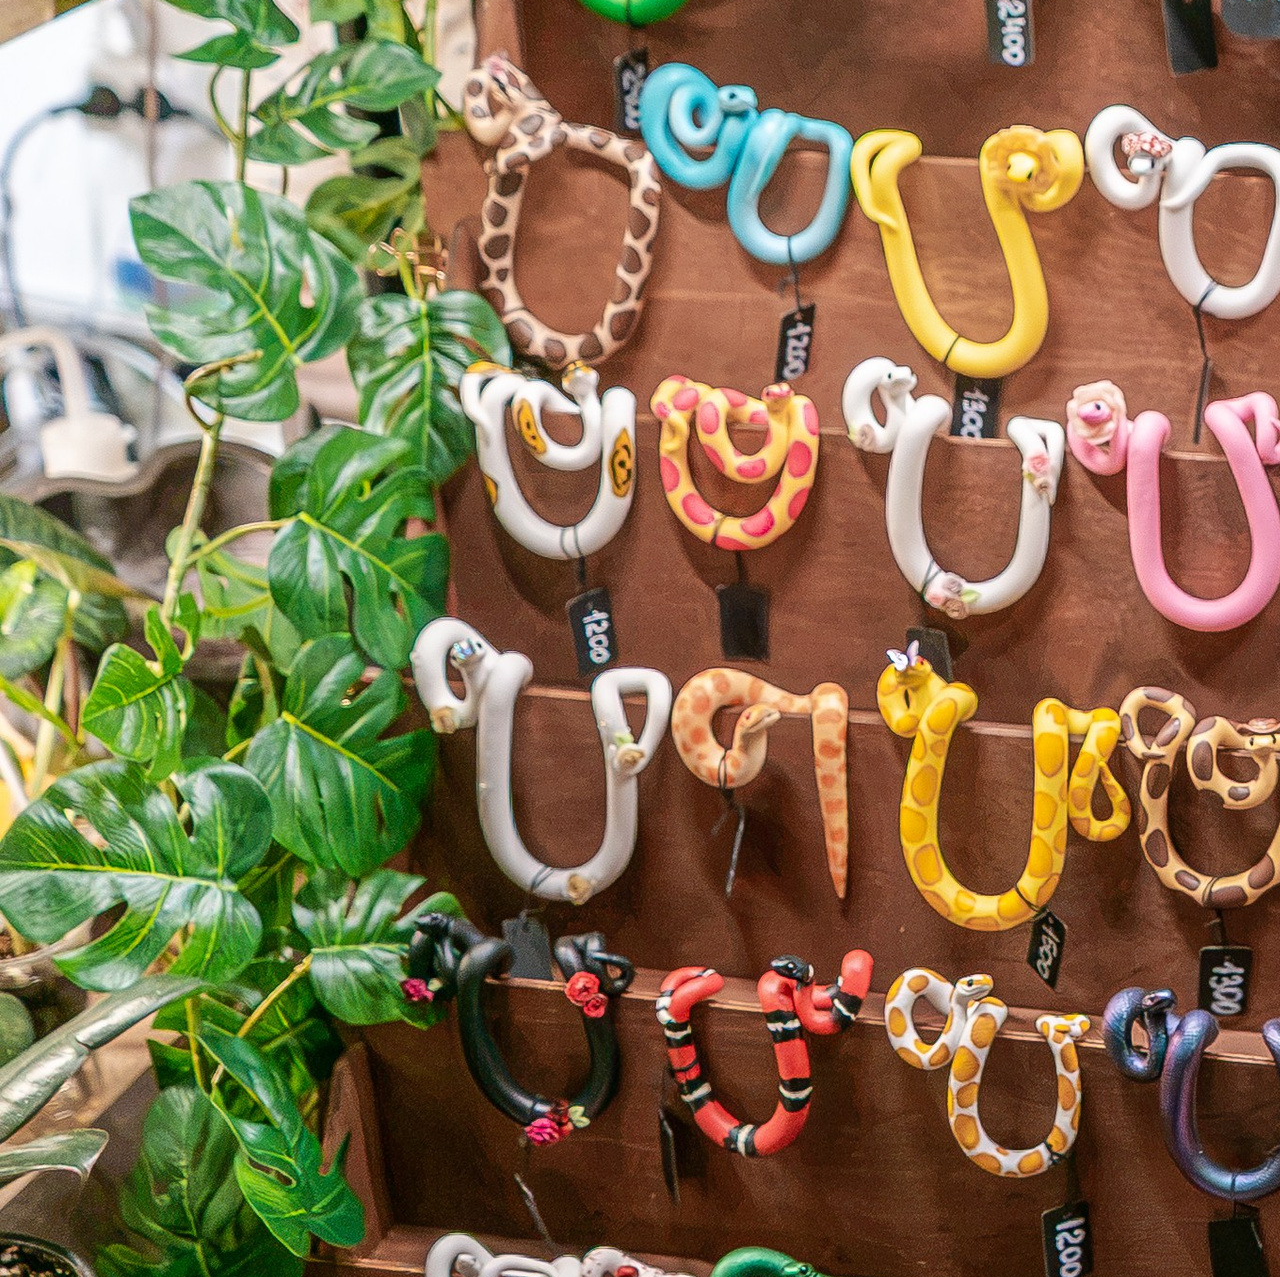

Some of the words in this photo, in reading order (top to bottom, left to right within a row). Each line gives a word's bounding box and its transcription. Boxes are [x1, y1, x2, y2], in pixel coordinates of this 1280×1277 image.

[959, 390, 989, 439] 1300
[582, 609, 611, 665] 1200
[1207, 960, 1245, 1017] 1300
